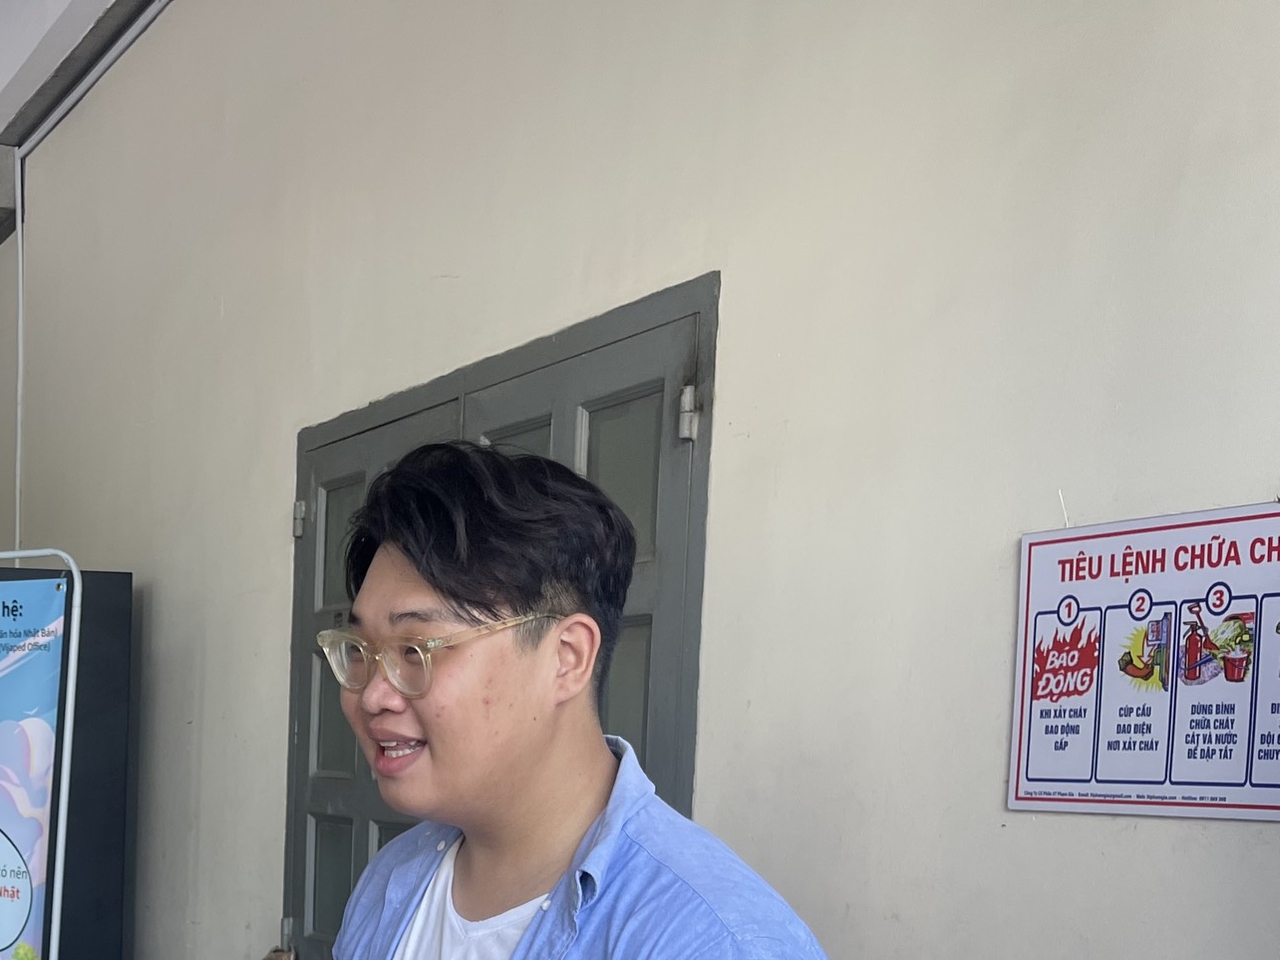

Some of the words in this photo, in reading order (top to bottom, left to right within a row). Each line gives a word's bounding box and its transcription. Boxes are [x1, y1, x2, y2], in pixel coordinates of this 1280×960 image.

[1058, 550, 1103, 582] TIÊU
[1110, 545, 1166, 584] LỆNH
[1174, 534, 1242, 571] CHỮA
[1135, 596, 1146, 613] 2
[1212, 590, 1224, 608] 3
[1, 600, 23, 622] hệ:
[1065, 601, 1073, 618] 1
[1039, 708, 1052, 719] KHI
[1068, 706, 1088, 719] CHÁY
[1118, 705, 1134, 718] CÚP
[1191, 702, 1213, 715] DÙNG
[1215, 701, 1236, 715] BÌNH
[1213, 716, 1235, 730] CHÁY
[1139, 738, 1160, 751] CHÁY
[10, 866, 28, 880] nên
